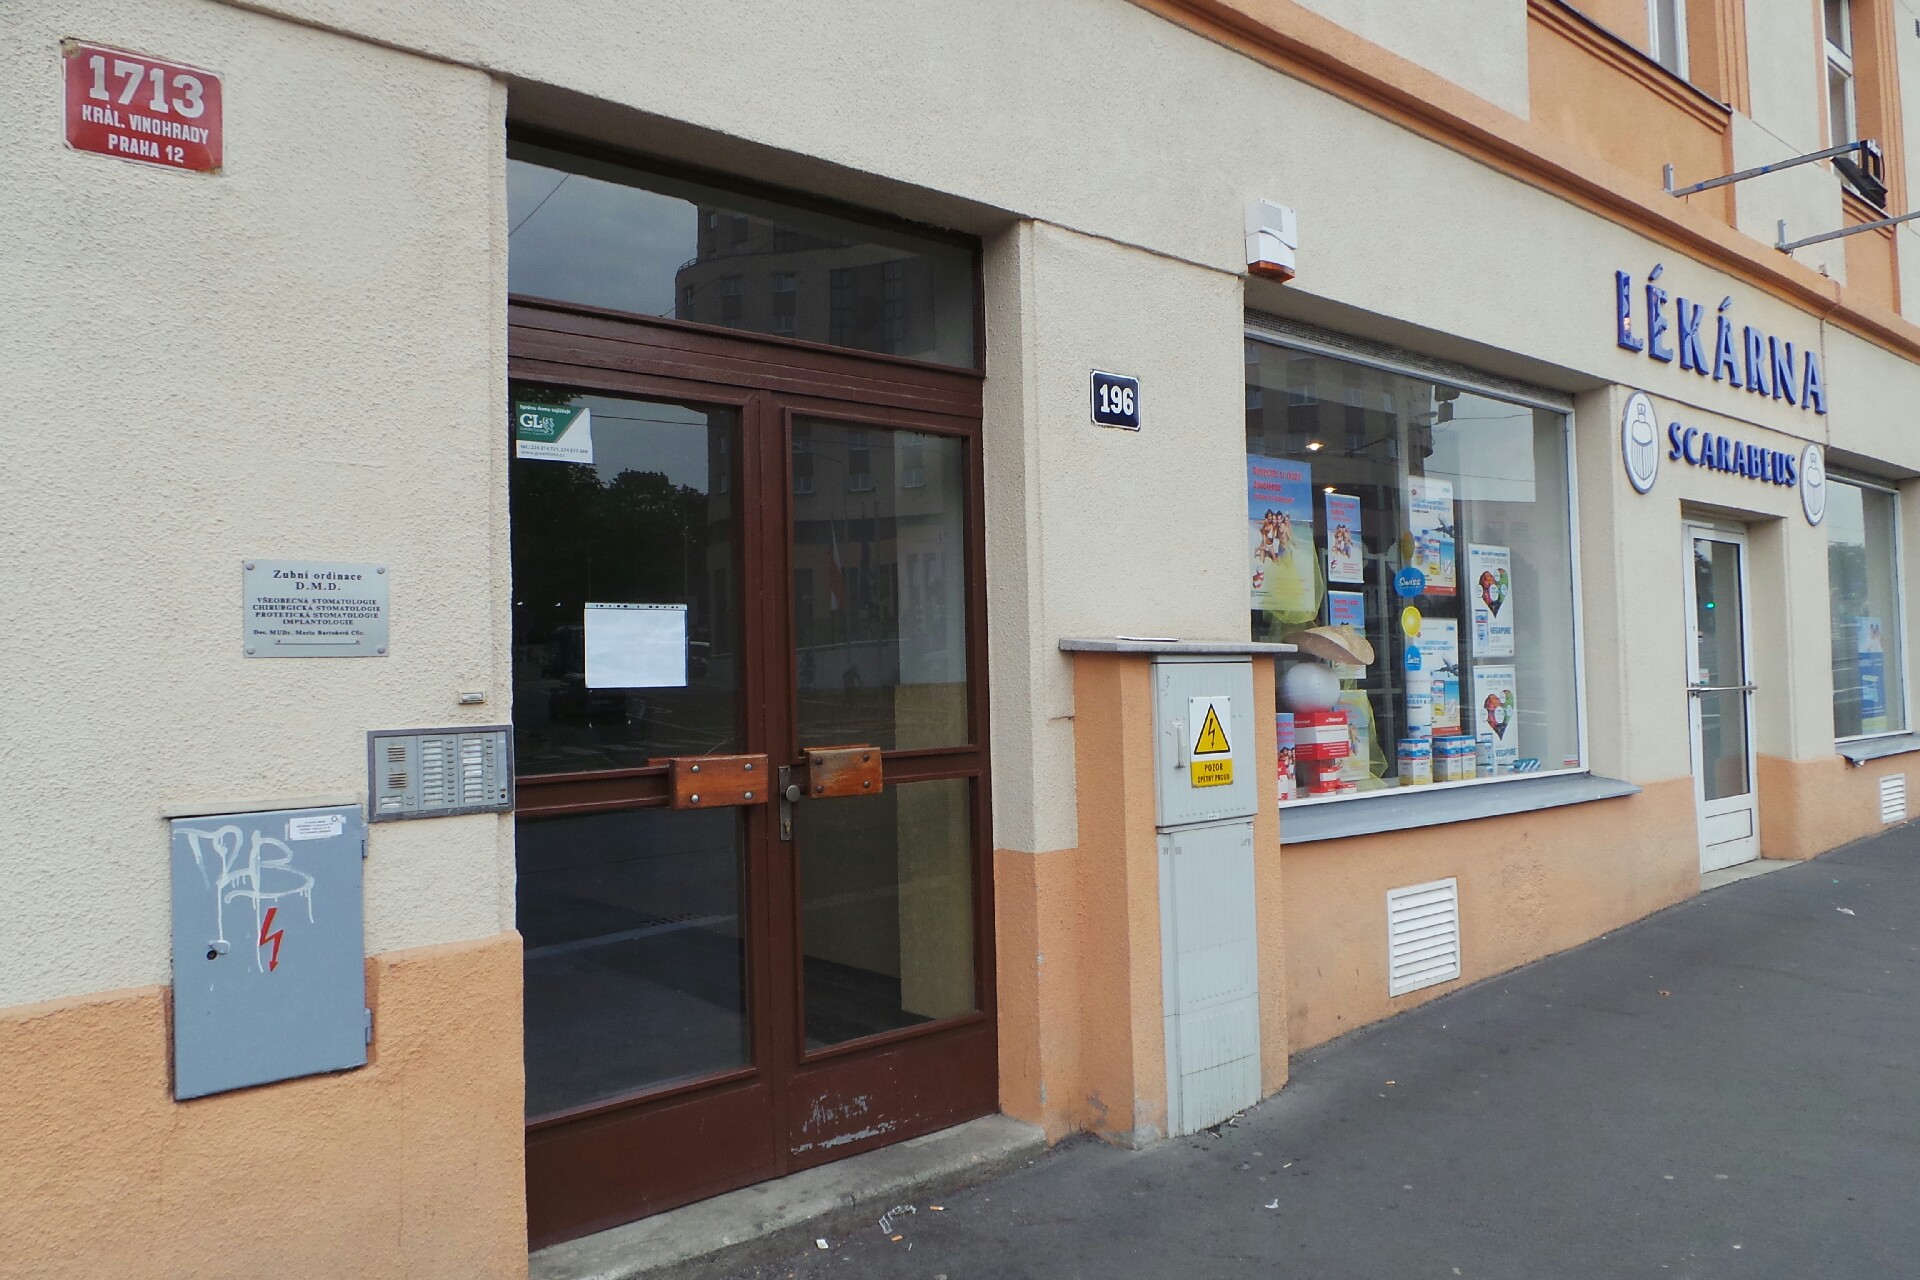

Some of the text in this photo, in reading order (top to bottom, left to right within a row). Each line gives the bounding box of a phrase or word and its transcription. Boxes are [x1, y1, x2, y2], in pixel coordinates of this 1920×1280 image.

[89, 55, 205, 118] 1713
[82, 104, 209, 146] KRÁL. VINOHRADY
[107, 133, 185, 163] PRAHA 12
[1615, 263, 1828, 415] LÉKÁRNA
[1099, 383, 1134, 416] 196
[1668, 421, 1799, 488] SCARABEUS
[273, 569, 362, 581] Zubní ordinace
[295, 581, 341, 591] D.M.D.
[311, 598, 378, 606] STOMATOLOGIE
[282, 618, 354, 626] IMPLANTOLOGIE
[1489, 625, 1512, 635] VEGAPURE
[1204, 762, 1224, 773] POZOR
